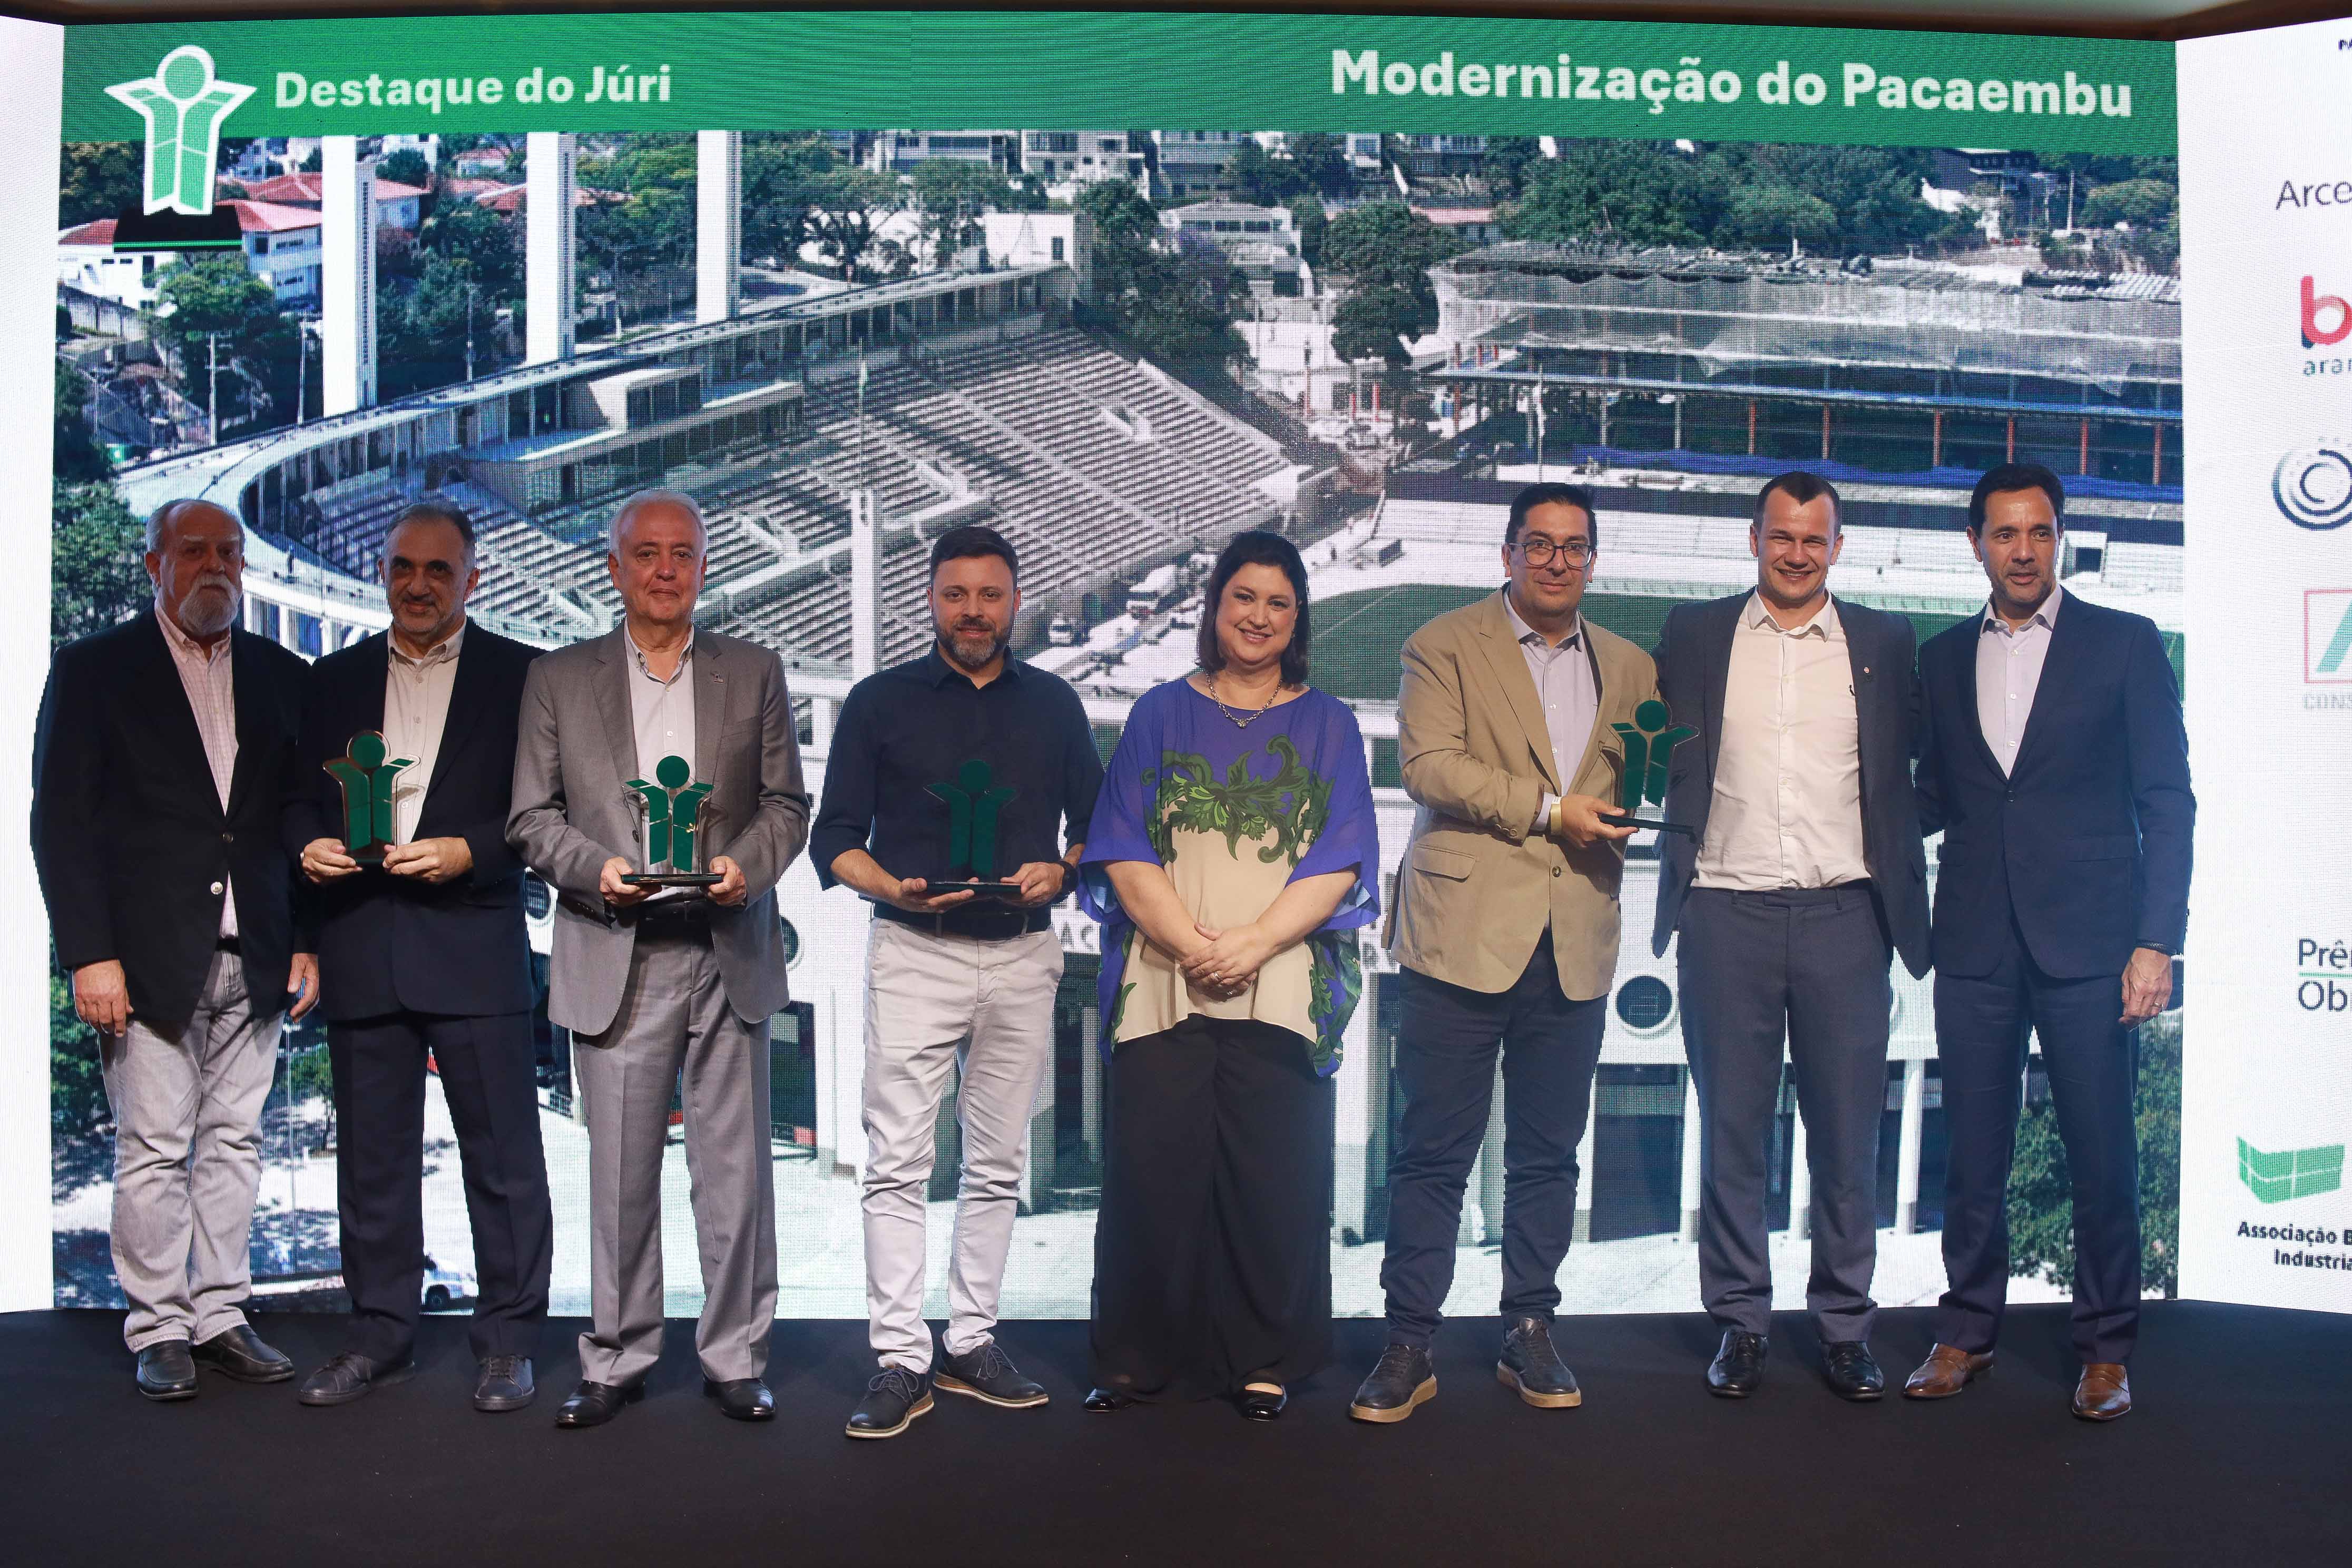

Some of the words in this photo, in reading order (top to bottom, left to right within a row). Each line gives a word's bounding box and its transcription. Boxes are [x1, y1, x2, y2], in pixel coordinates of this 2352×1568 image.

[275, 72, 503, 114] Destaque
[515, 67, 574, 103] do
[584, 64, 671, 103] Júri
[1332, 50, 1742, 114] Modernização
[1757, 61, 1827, 105] do
[1843, 63, 2131, 117] Pacaembu
[2276, 180, 2352, 210] Arce
[2299, 938, 2352, 969] Prê
[2298, 980, 2352, 1011] Ob
[2237, 1221, 2337, 1247] Associação
